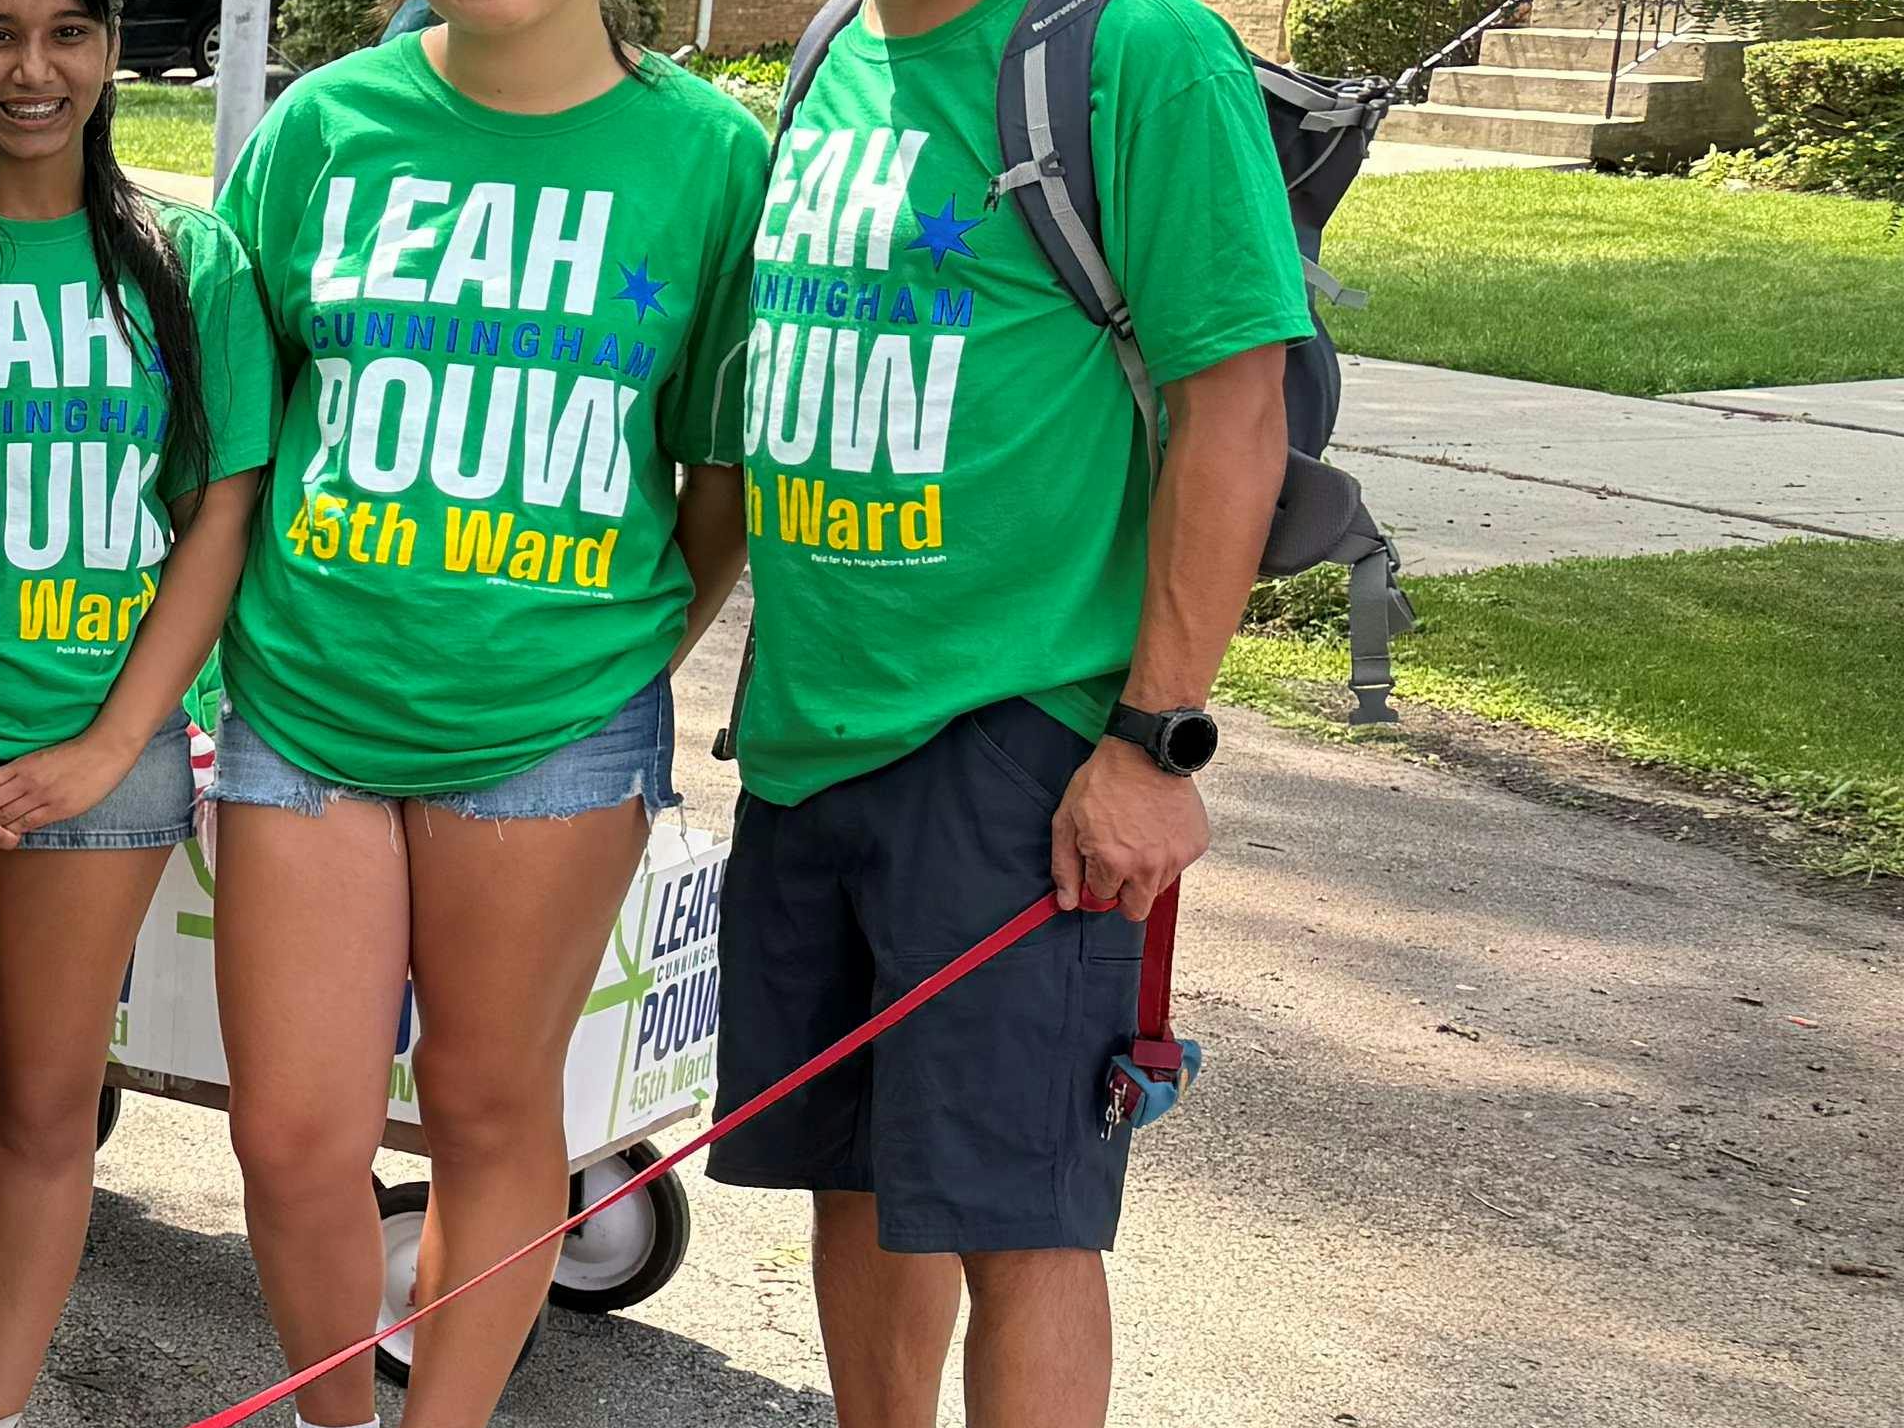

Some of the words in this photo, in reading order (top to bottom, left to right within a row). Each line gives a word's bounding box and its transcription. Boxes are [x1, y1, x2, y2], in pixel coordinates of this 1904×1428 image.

[310, 176, 613, 316] LEAH
[754, 129, 929, 270] EAH
[311, 312, 656, 381] CUNNINGHAM
[743, 318, 965, 474] OUW
[302, 356, 639, 518] POUW
[286, 493, 418, 566] 45th
[445, 505, 619, 589] Ward
[778, 474, 941, 551] Ward
[651, 858, 727, 960] LEAH
[629, 1065, 666, 1113] 45th
[670, 1042, 713, 1094] Ward
